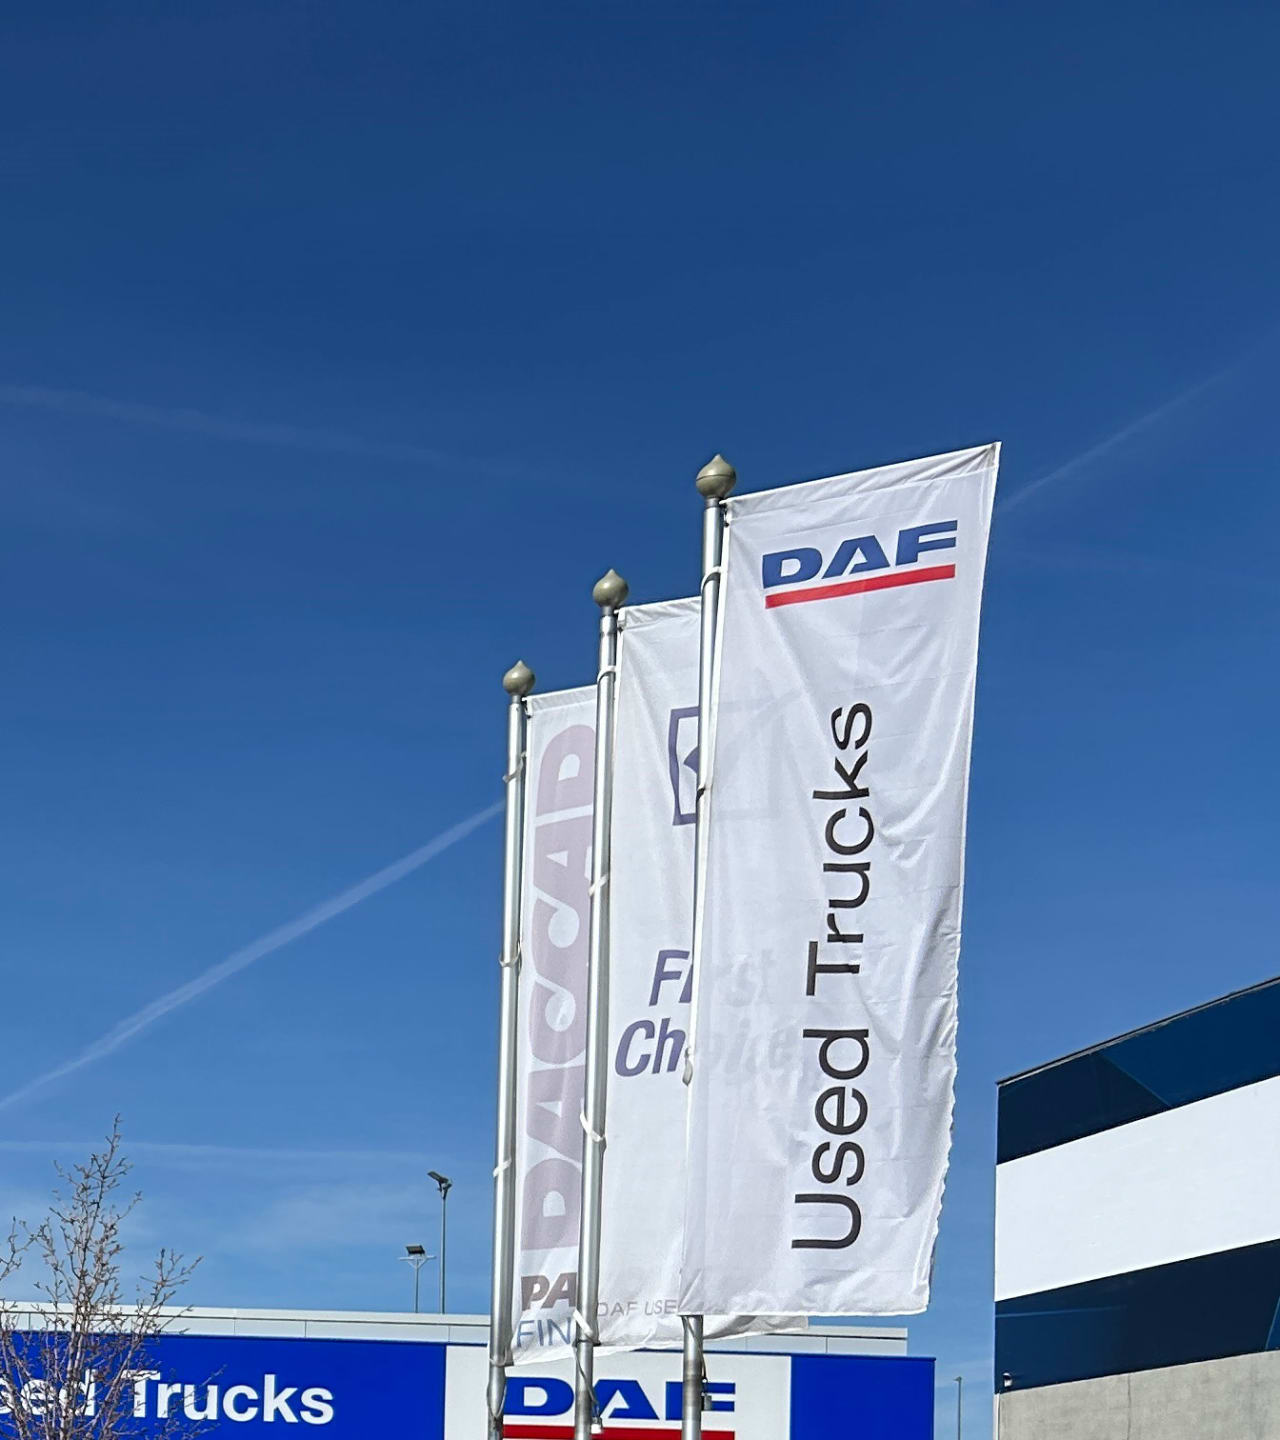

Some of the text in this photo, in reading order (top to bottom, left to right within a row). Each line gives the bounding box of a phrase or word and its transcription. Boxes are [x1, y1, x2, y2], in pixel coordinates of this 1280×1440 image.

[762, 520, 958, 589] DAF
[791, 702, 874, 1249] Used Trucks
[122, 1369, 334, 1425] Trucks
[503, 1376, 736, 1420] DAF
